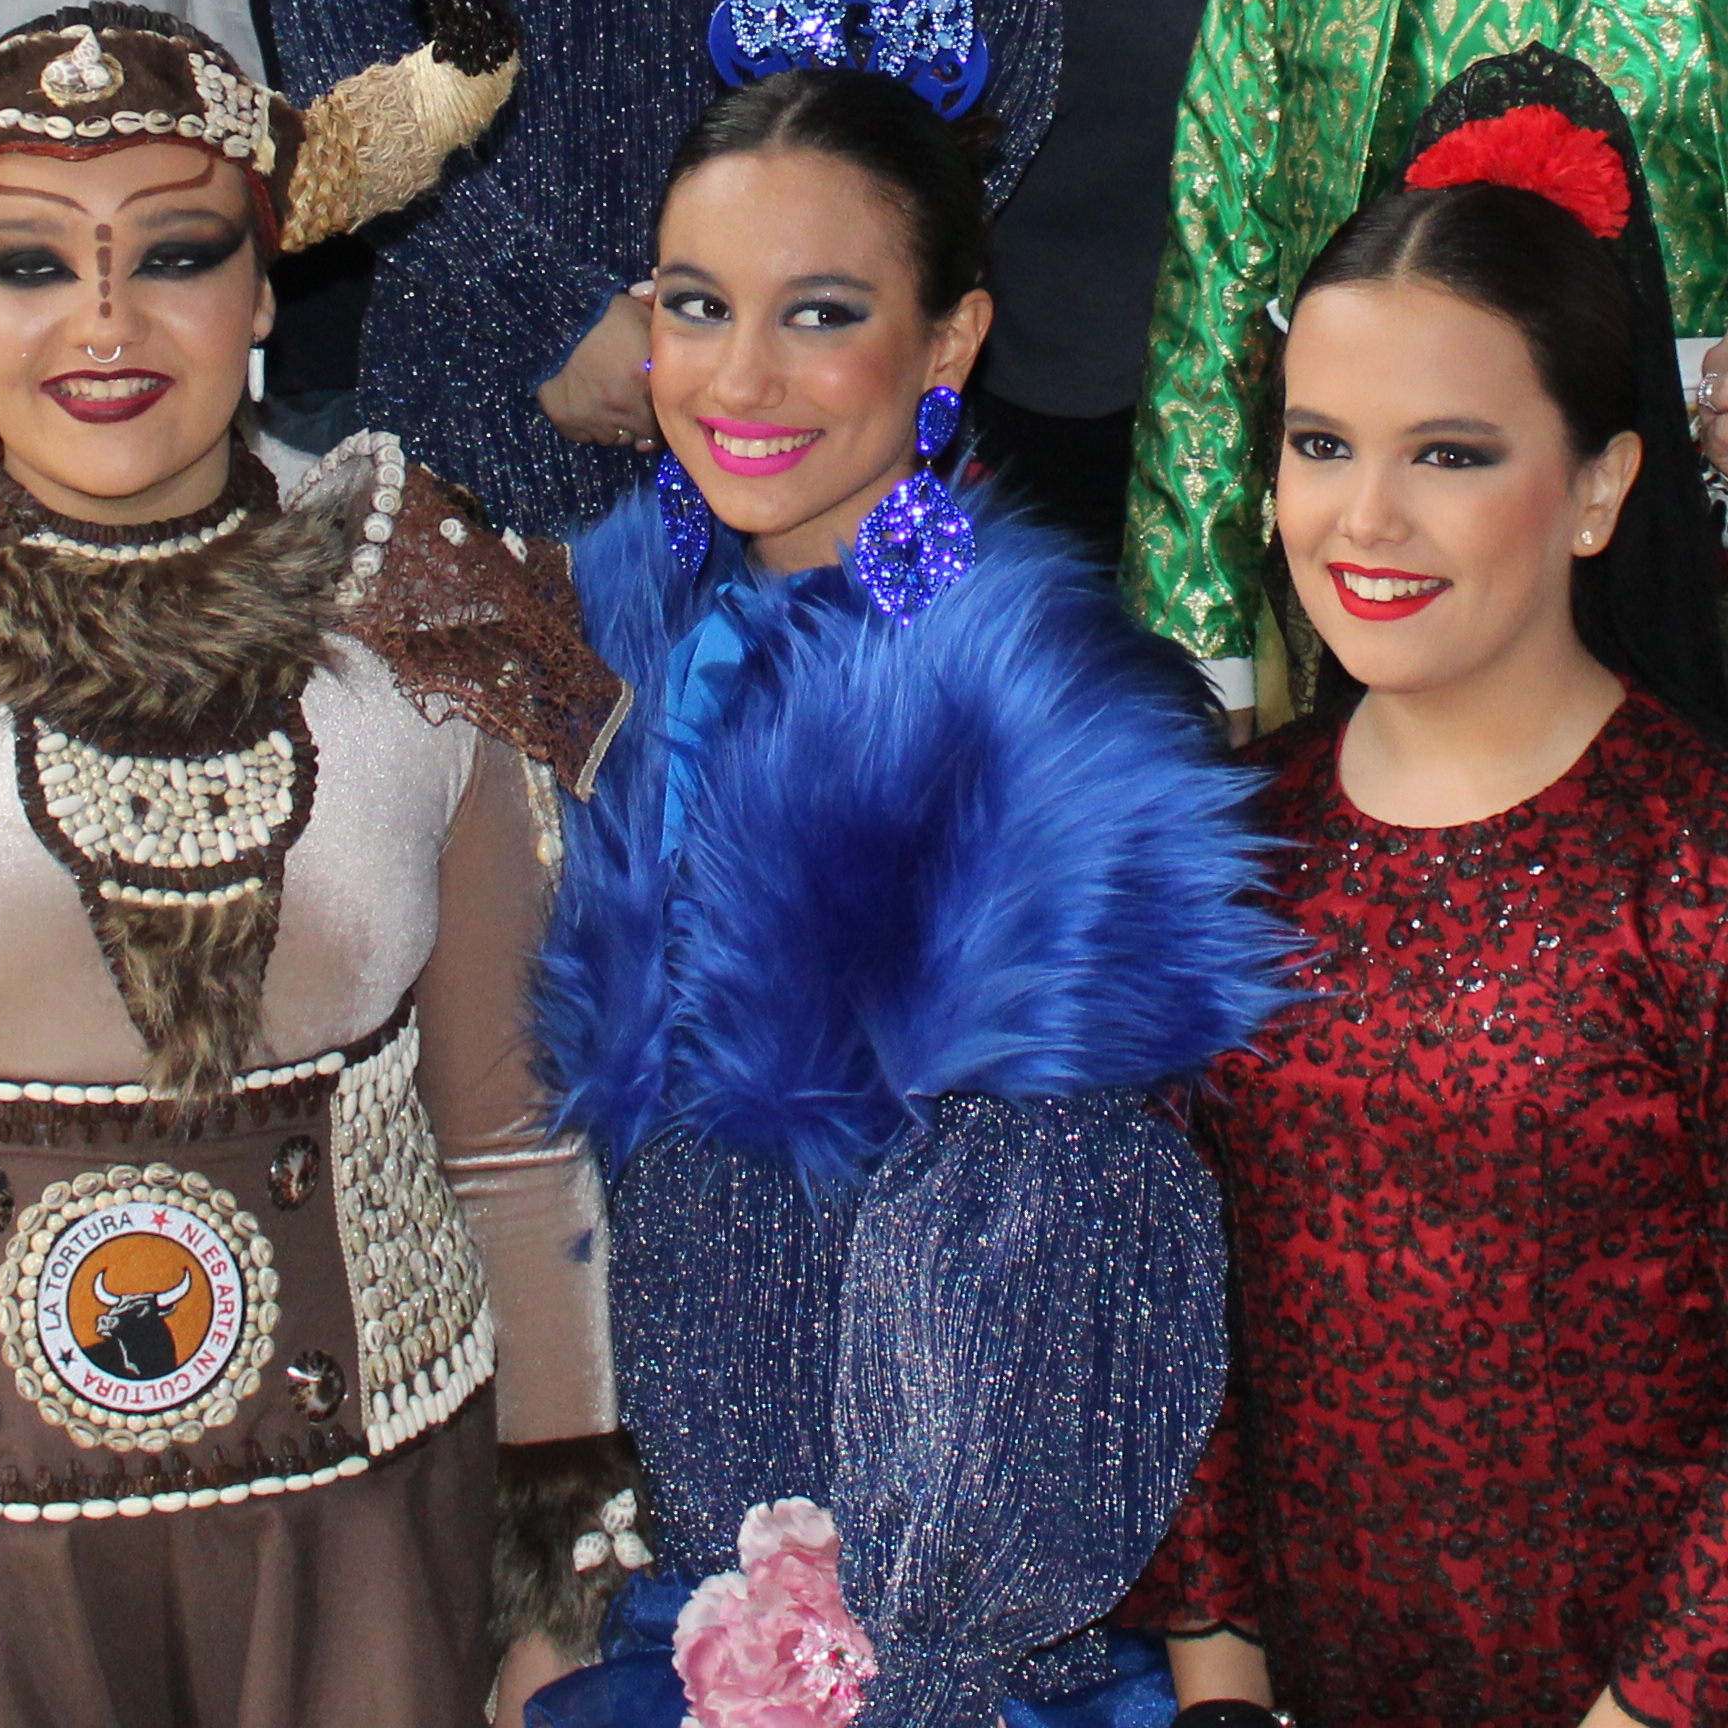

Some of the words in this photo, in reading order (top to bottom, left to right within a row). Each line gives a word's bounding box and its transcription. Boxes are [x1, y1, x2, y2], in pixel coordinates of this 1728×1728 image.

[179, 1223, 207, 1247] NI
[44, 1210, 134, 1294] TORTURA
[202, 1243, 228, 1276] ES
[43, 1301, 61, 1331] LA
[210, 1283, 236, 1347] ARTE
[194, 1350, 216, 1376] NI
[81, 1368, 191, 1404] CULTURA
